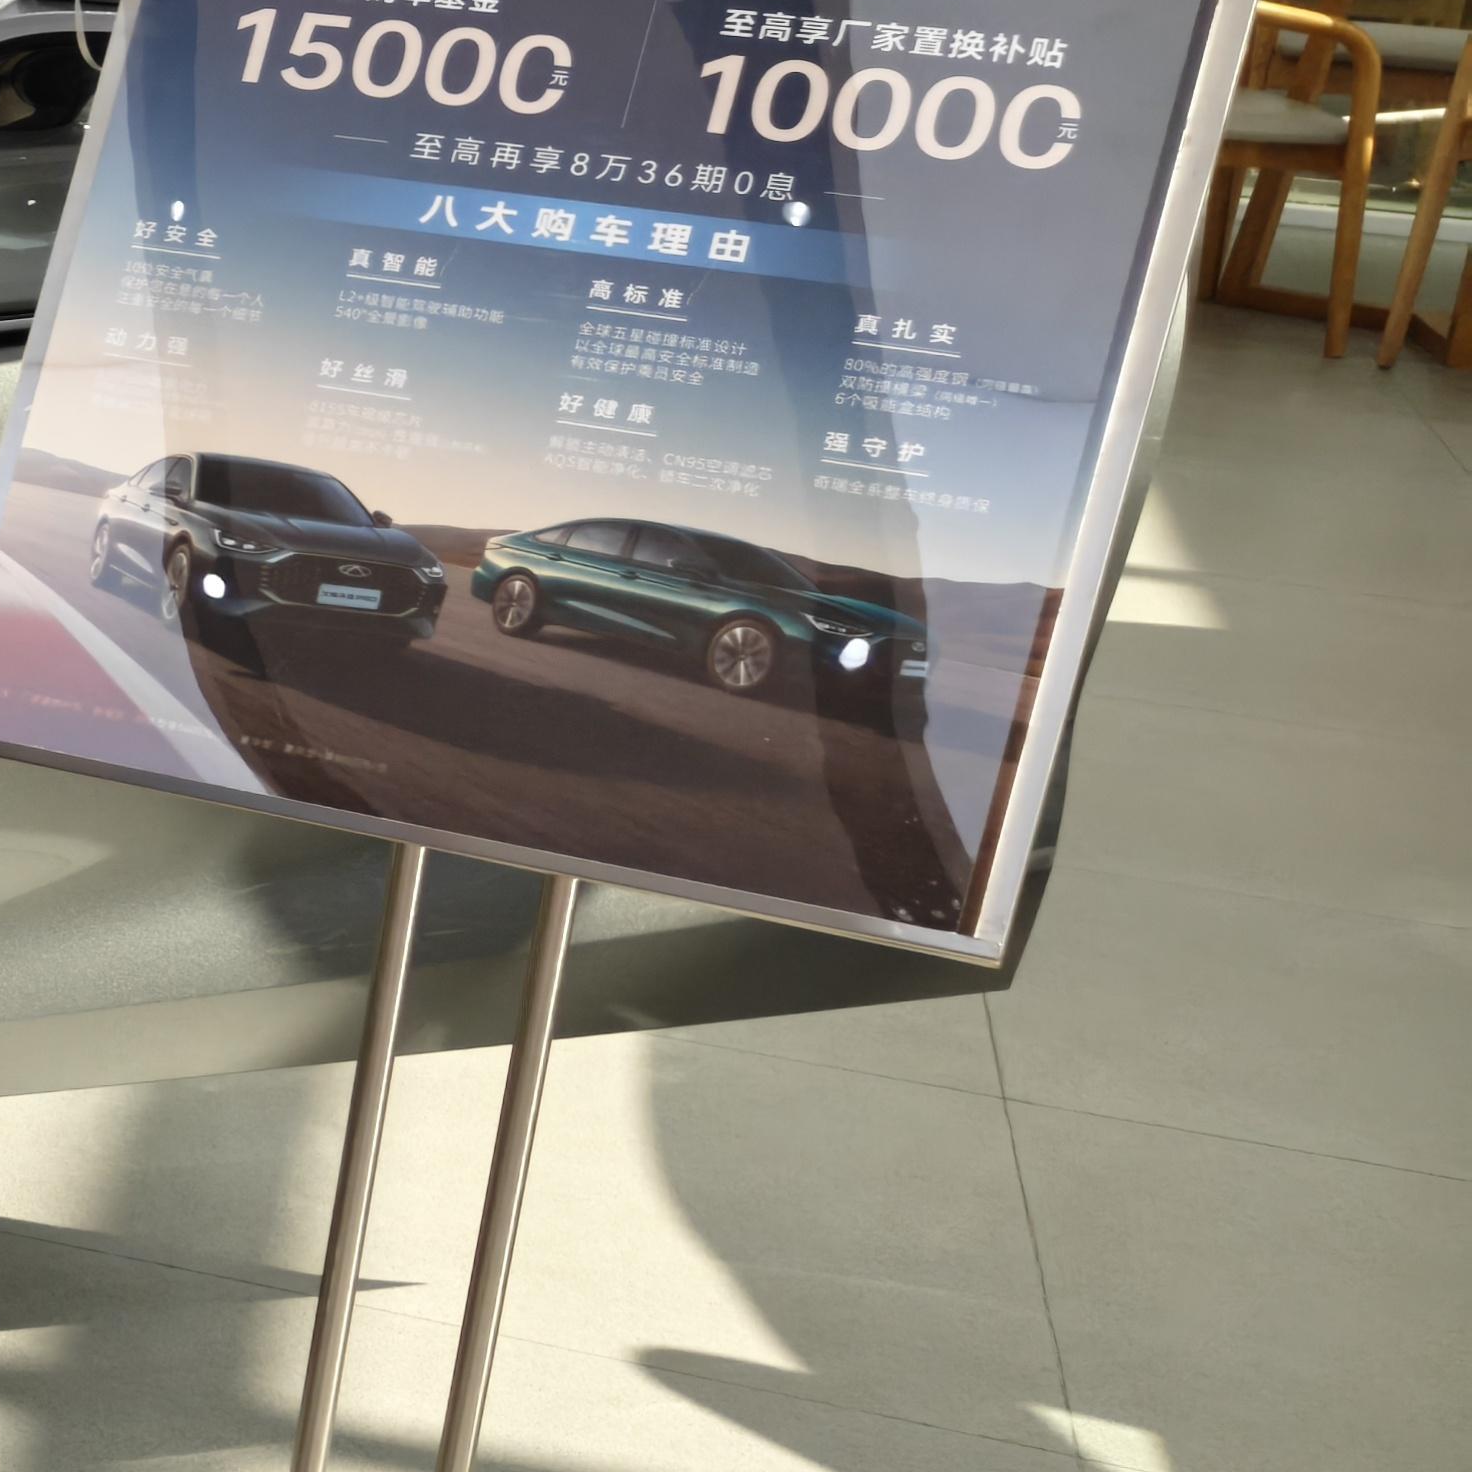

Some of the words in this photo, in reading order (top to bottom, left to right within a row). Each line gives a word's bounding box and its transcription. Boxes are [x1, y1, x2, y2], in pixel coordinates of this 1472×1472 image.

[719, 8, 1069, 69] 至高享厂家置换补贴
[133, 219, 219, 248] 好安全
[419, 194, 752, 264] 八大购车理由
[348, 248, 438, 277] 真智能
[589, 279, 685, 309] 高标准
[103, 327, 189, 356] 动力强
[853, 313, 957, 345] 真扎实
[319, 358, 408, 389] 好丝滑
[558, 392, 655, 425] 好健康
[823, 431, 926, 463] 强守护
